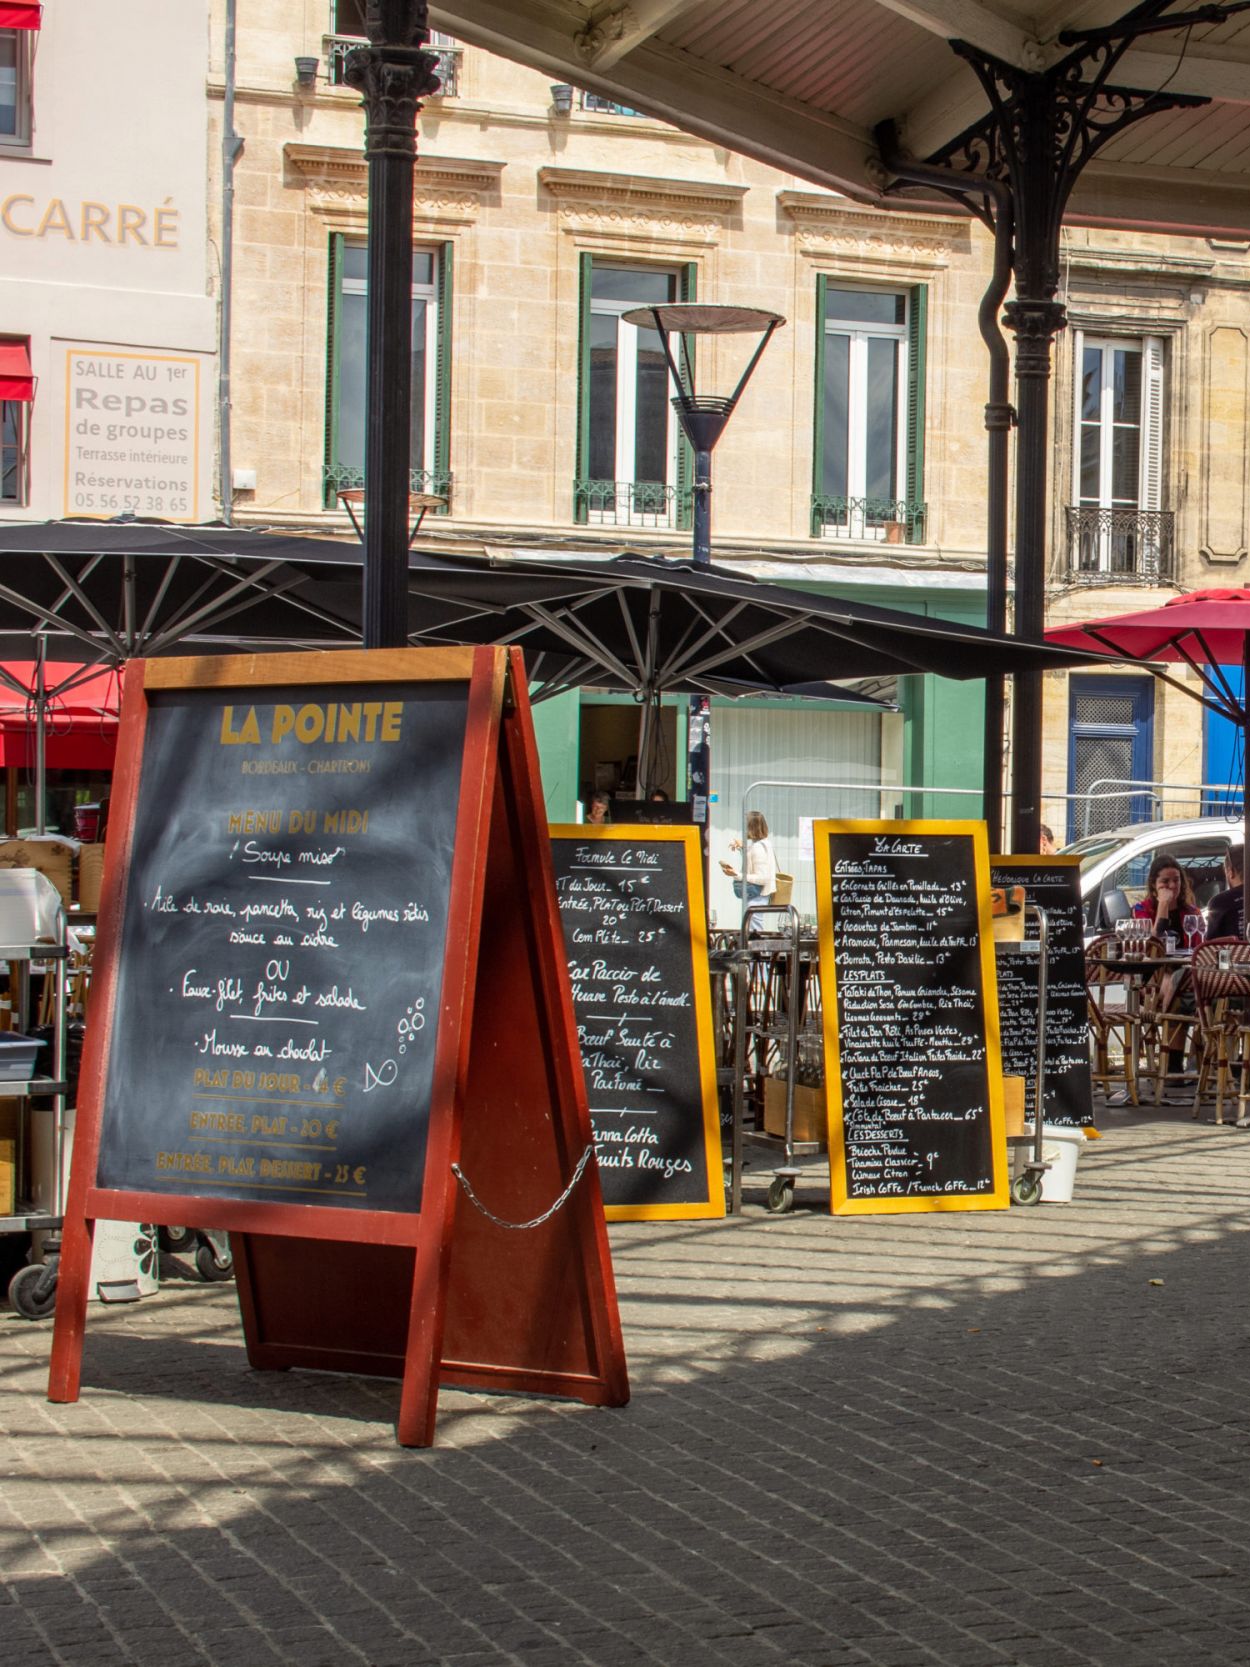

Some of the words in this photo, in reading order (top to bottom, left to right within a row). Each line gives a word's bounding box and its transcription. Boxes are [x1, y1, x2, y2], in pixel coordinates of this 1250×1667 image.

[1, 194, 180, 248] CARRÉ
[76, 361, 125, 379] SALLE
[133, 364, 157, 381] AU
[167, 366, 187, 382] 1er
[75, 388, 188, 417] Repas
[76, 419, 100, 436] de
[107, 422, 188, 443] groupes
[76, 447, 127, 463] Terrasse
[129, 448, 188, 465] intérieure
[75, 472, 188, 492] Réservations
[220, 705, 261, 744] LA
[272, 702, 404, 744] POINTE
[241, 760, 297, 774] BORDEAUX
[308, 759, 371, 774] CHARTRONS
[228, 810, 281, 834] MENU
[288, 811, 317, 833] DU
[324, 810, 369, 834] MIDI
[242, 840, 291, 868] Soupe
[575, 846, 616, 864] Formule
[151, 885, 178, 913] Aile
[183, 899, 201, 914] de
[204, 899, 237, 917] raie,
[240, 898, 299, 923] pancetta,
[307, 901, 327, 931] riz
[331, 902, 345, 919] et
[352, 902, 399, 931] légumes
[230, 929, 265, 945] sauce
[273, 933, 294, 946] au
[301, 930, 339, 947] cidre
[267, 960, 289, 981] OU
[641, 966, 661, 981] de
[254, 981, 288, 1016] frites
[293, 989, 311, 1005] et
[315, 988, 366, 1010] salade
[640, 992, 651, 1005] à
[200, 1029, 249, 1057] Mousse
[254, 1044, 273, 1057] au
[276, 1039, 332, 1061] chocolat
[660, 1033, 675, 1048] à
[194, 1068, 228, 1088] PLAT
[233, 1071, 254, 1089] DU
[257, 1071, 300, 1092] JOUR
[333, 1077, 347, 1097] €
[190, 1112, 247, 1133] ENTRÉE,
[252, 1117, 288, 1136] PLAT
[300, 1119, 320, 1138] 20
[325, 1121, 339, 1139] €
[625, 1125, 659, 1144] Cotta
[156, 1152, 215, 1173] ENTRÉE,
[218, 1156, 256, 1176] PLAT,
[260, 1159, 322, 1181] DESSERT
[335, 1164, 349, 1183] 25
[353, 1166, 367, 1185] €
[638, 1149, 692, 1178] Rouges
